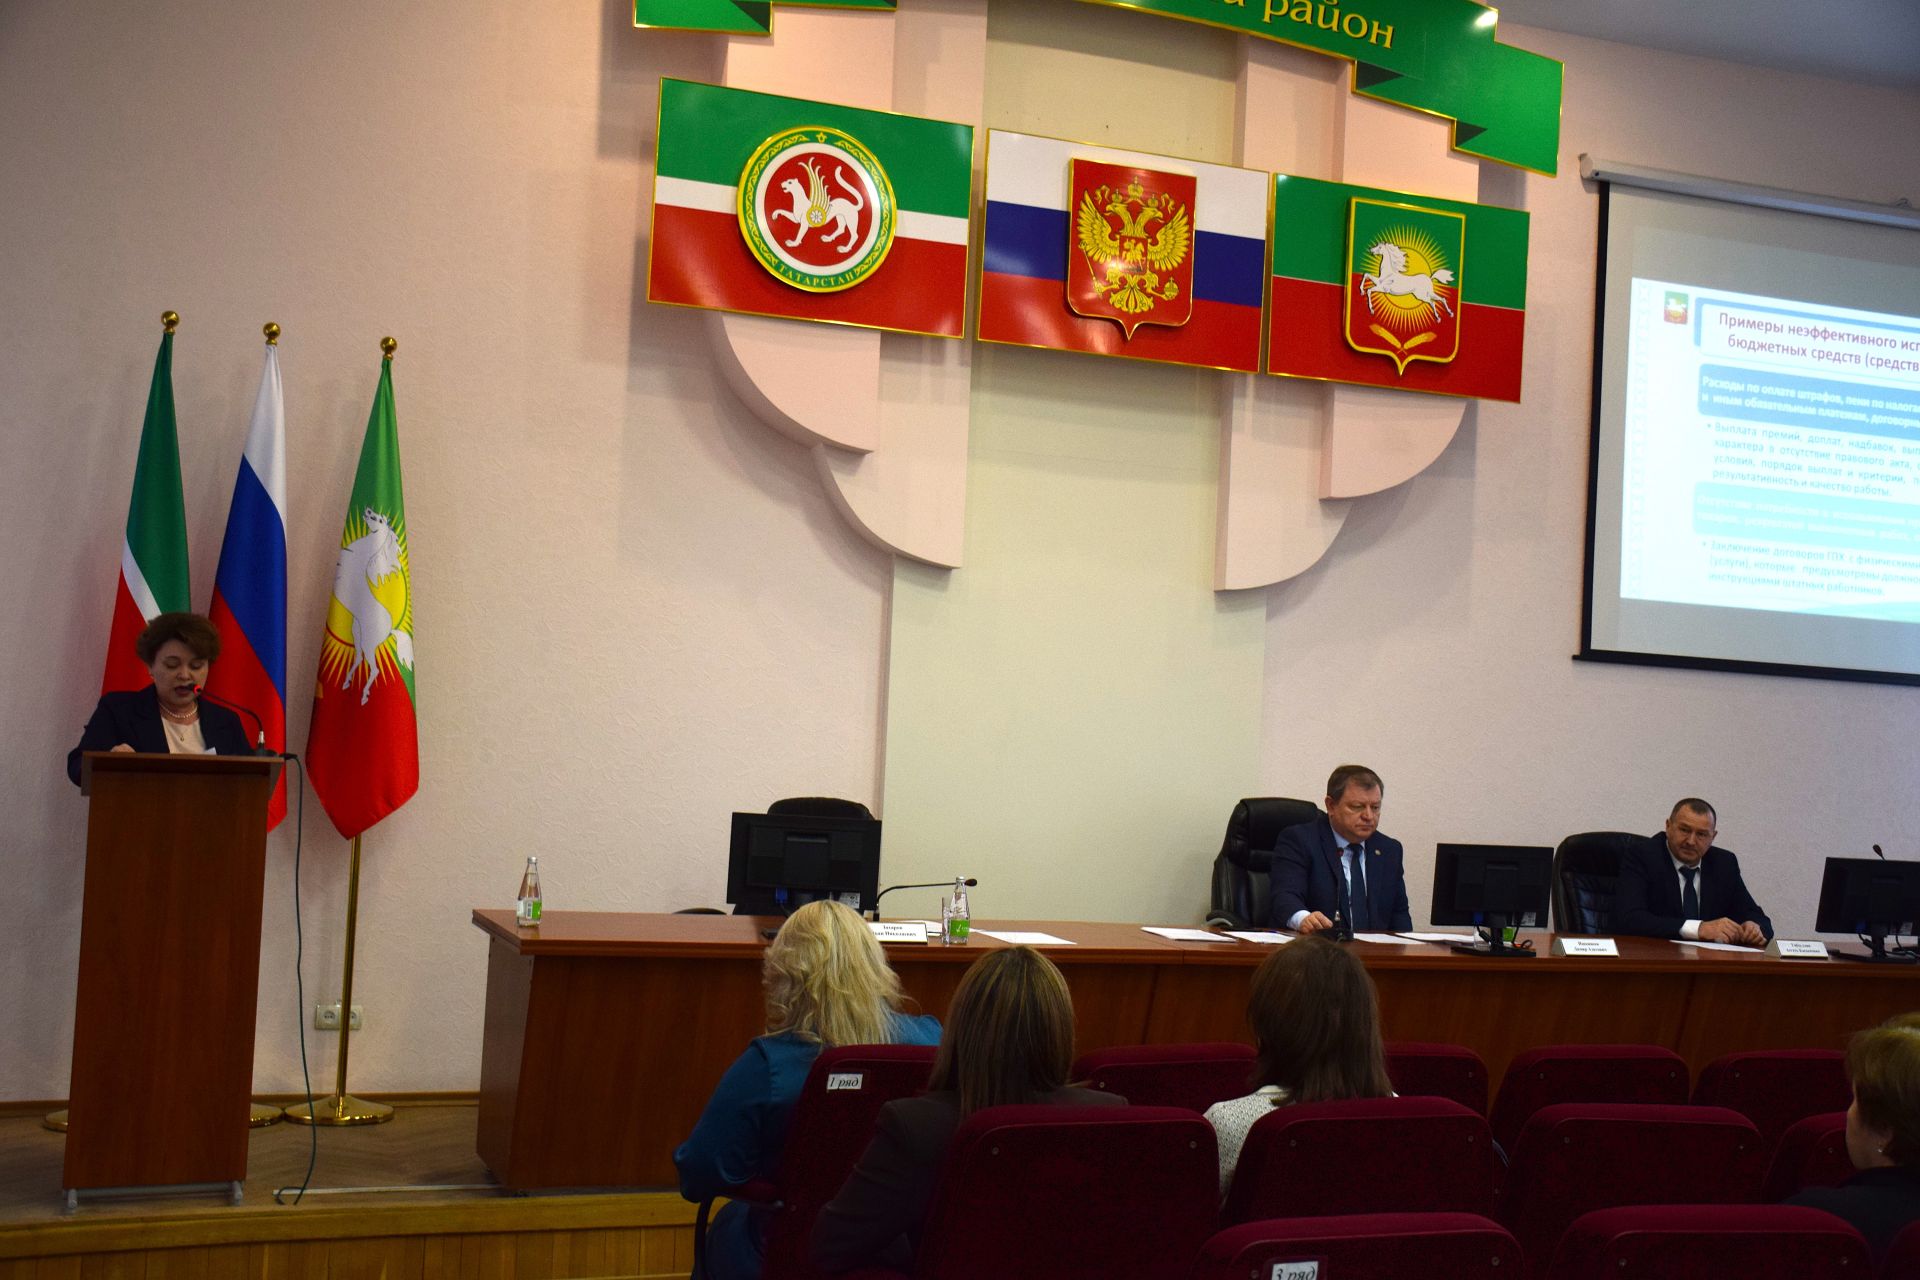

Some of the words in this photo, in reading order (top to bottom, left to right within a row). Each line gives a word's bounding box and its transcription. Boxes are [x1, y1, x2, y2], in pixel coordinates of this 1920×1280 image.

[778, 263, 855, 286] ТАТАРСТАН
[1719, 312, 1784, 334] Примеры
[1788, 325, 1897, 349] неэффективного
[1728, 333, 1807, 357] бюджетных
[1811, 348, 1861, 365] средств
[1702, 376, 1745, 392] Расходы
[1746, 383, 1760, 393] по
[1761, 385, 1796, 398] оплате
[1871, 399, 1884, 409] по
[1714, 422, 1757, 437] Выплата
[1713, 440, 1764, 453] характера
[1780, 447, 1831, 460] отсутствие
[1835, 453, 1885, 466] правового
[1761, 460, 1804, 473] порядок
